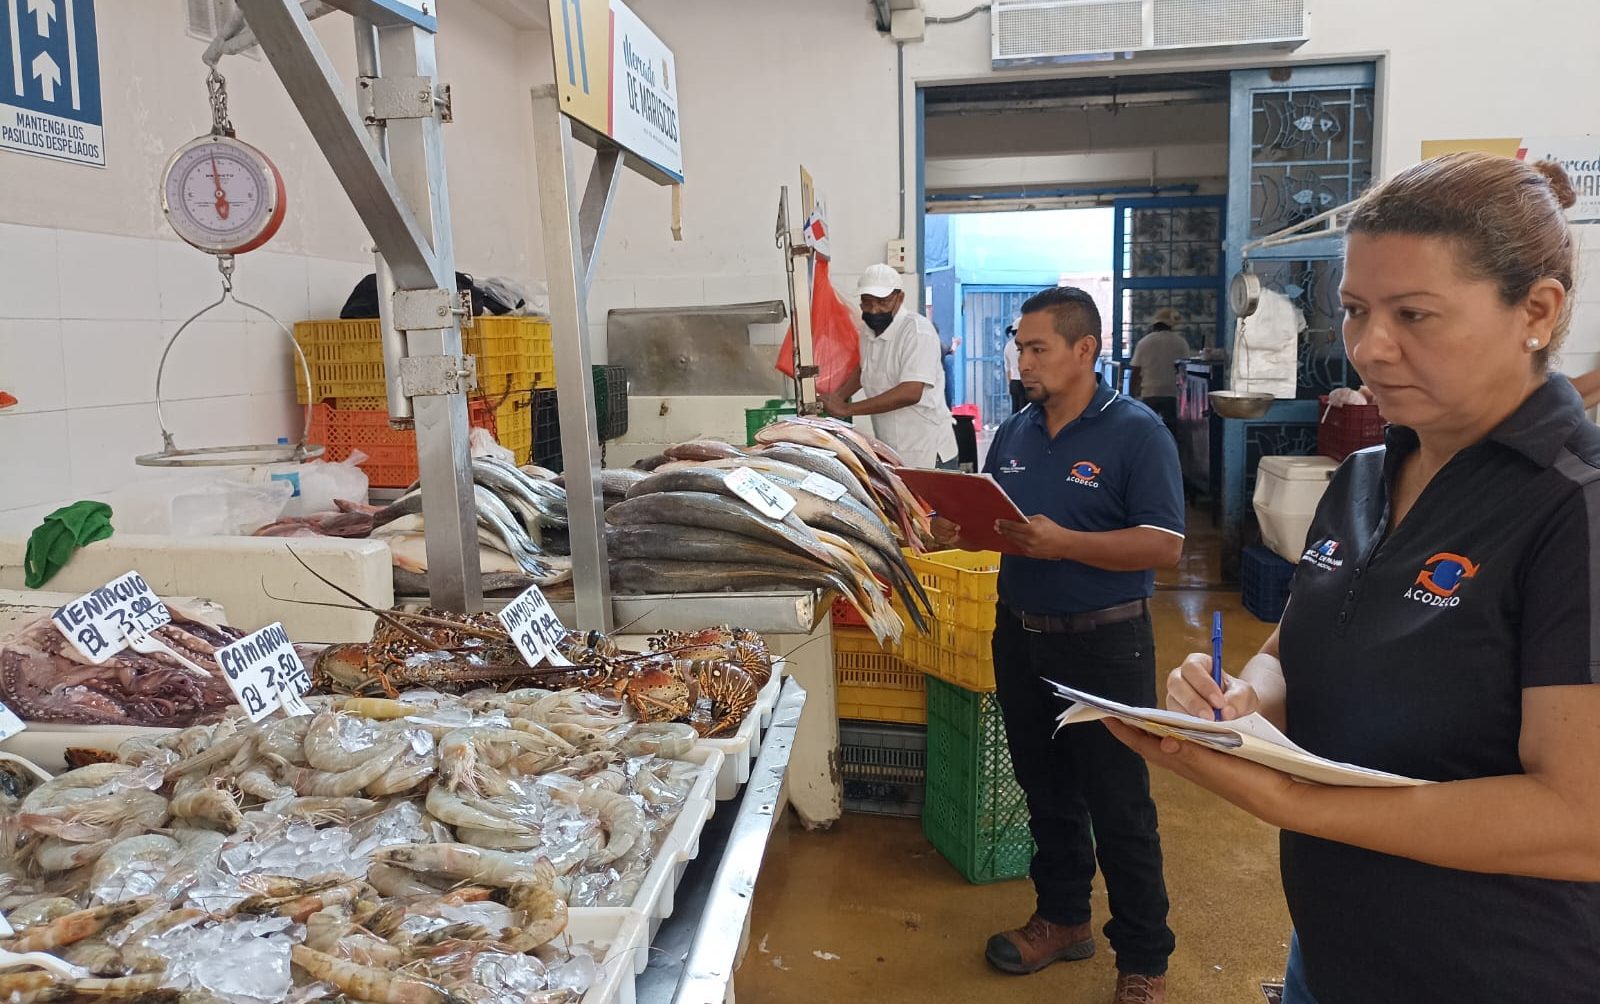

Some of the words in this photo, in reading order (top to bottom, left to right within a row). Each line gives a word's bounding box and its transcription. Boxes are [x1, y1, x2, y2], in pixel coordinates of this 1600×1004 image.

[16, 112, 67, 137] MANTENGA
[68, 124, 84, 140] LOS
[626, 71, 640, 114] DE
[640, 84, 678, 143] MARISCOS
[2, 126, 44, 148] PASILLOS
[46, 135, 99, 159] DESPEJADOS
[1065, 476, 1099, 488] ACODECO
[52, 575, 148, 633] TENTACULO
[221, 625, 290, 680] CAMARON
